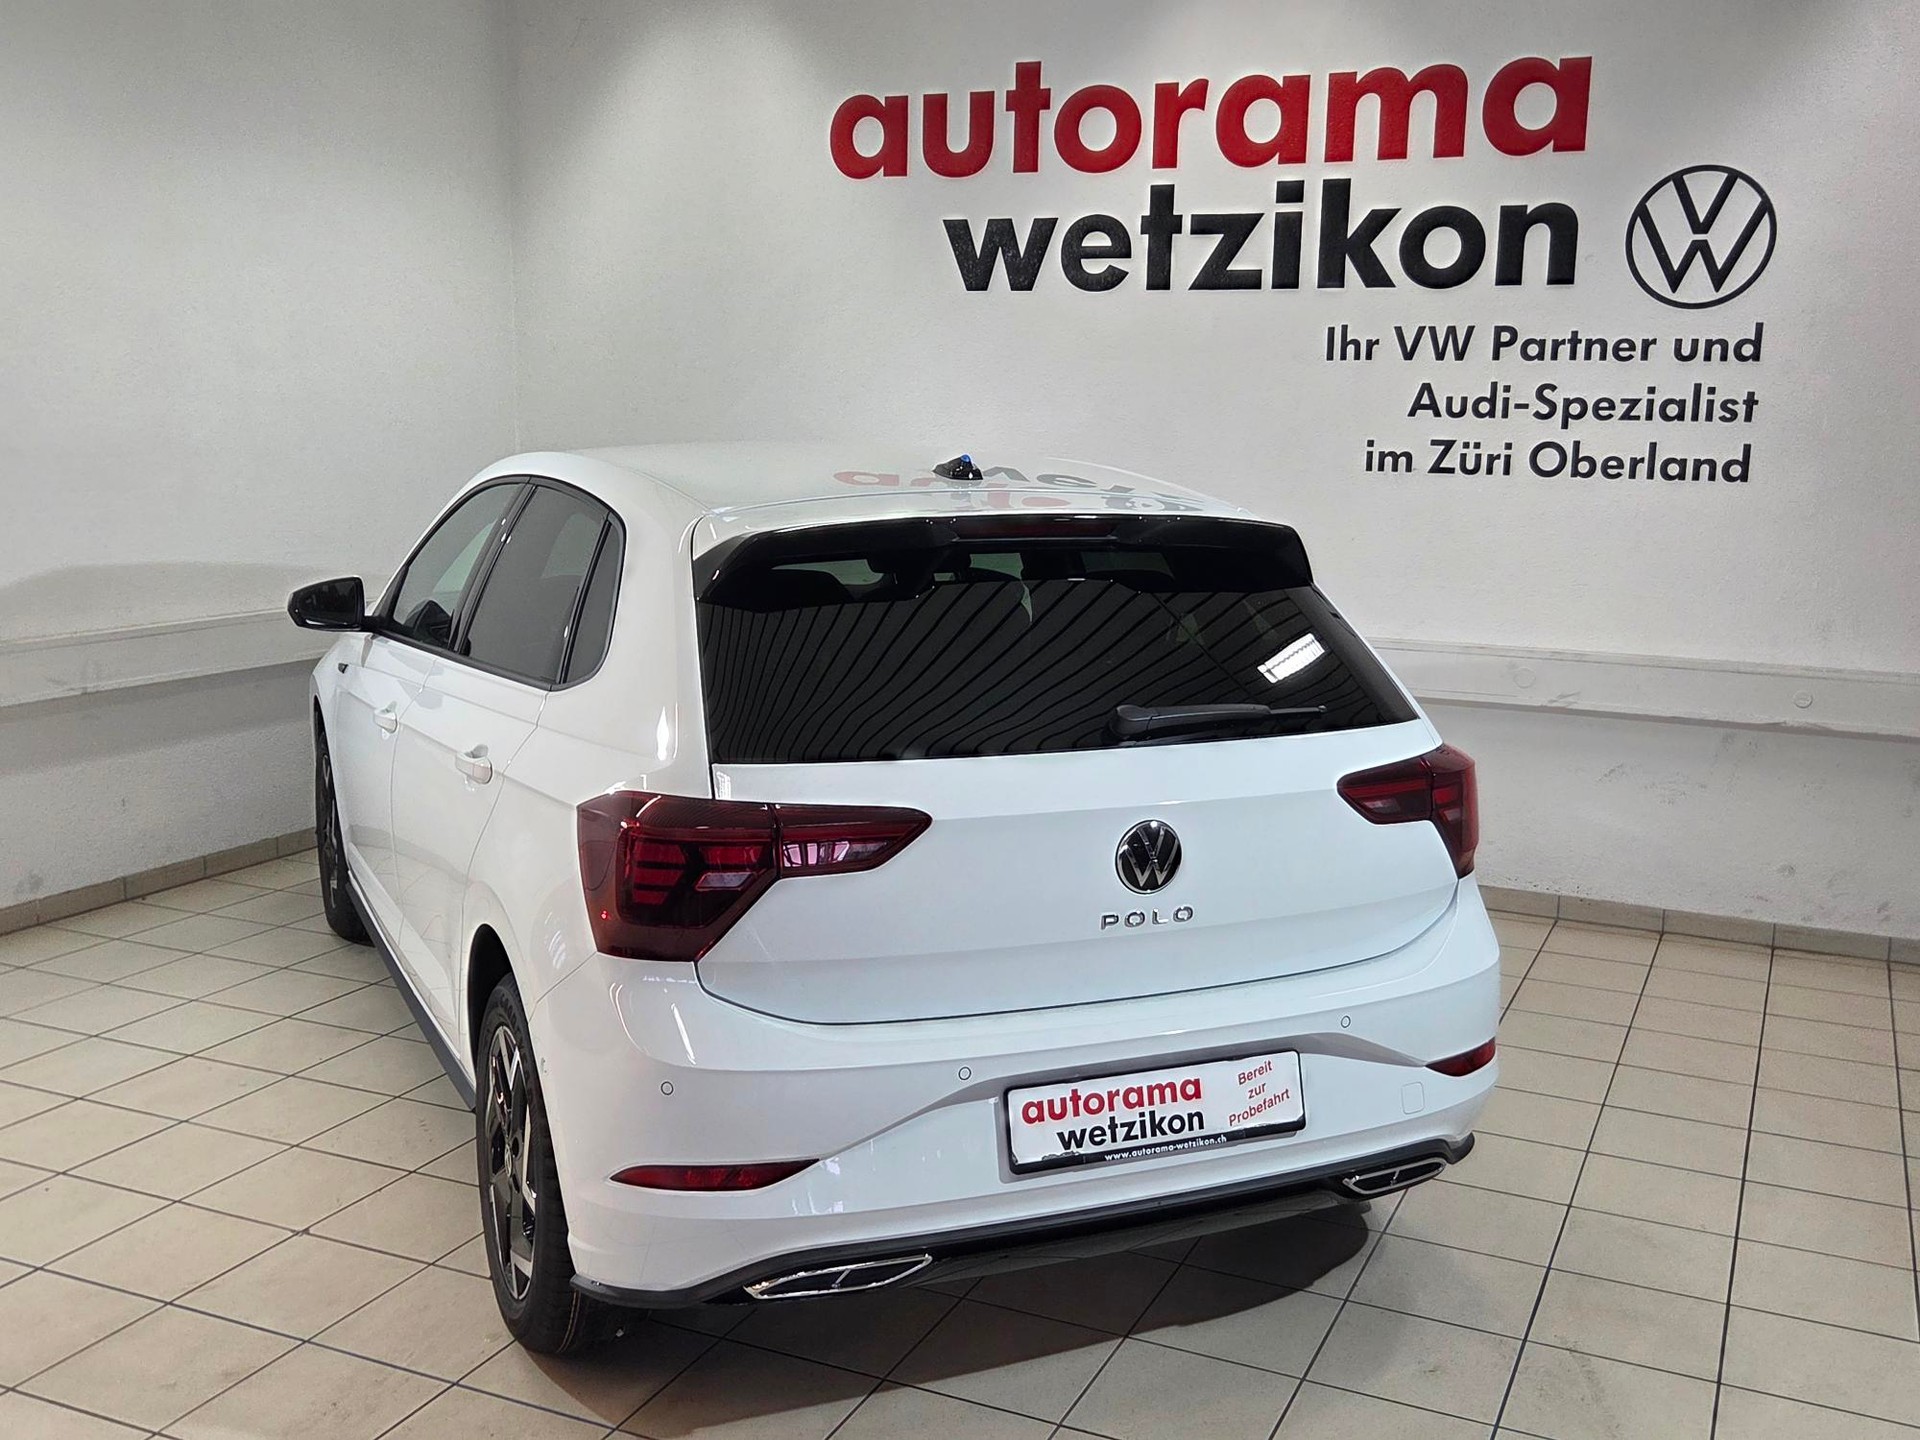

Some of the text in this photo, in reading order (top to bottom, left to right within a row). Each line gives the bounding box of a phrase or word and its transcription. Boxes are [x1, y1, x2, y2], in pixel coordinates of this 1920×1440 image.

[830, 56, 1592, 179] autorama
[943, 178, 1579, 292] wetzikon
[1326, 323, 1764, 363] Ihr VW Partner und
[1407, 382, 1760, 430] Audi-Spezialist
[1365, 439, 1752, 483] im Züri Oberland
[1101, 906, 1193, 930] POLO
[1237, 1060, 1273, 1086] Bereit
[1247, 1082, 1267, 1099] zur
[1021, 1077, 1202, 1125] autorama
[1228, 1088, 1290, 1127] Probefahrt
[1056, 1111, 1205, 1151] wetzikon
[1104, 1134, 1228, 1162] www.autorama-wetzikon.ch
